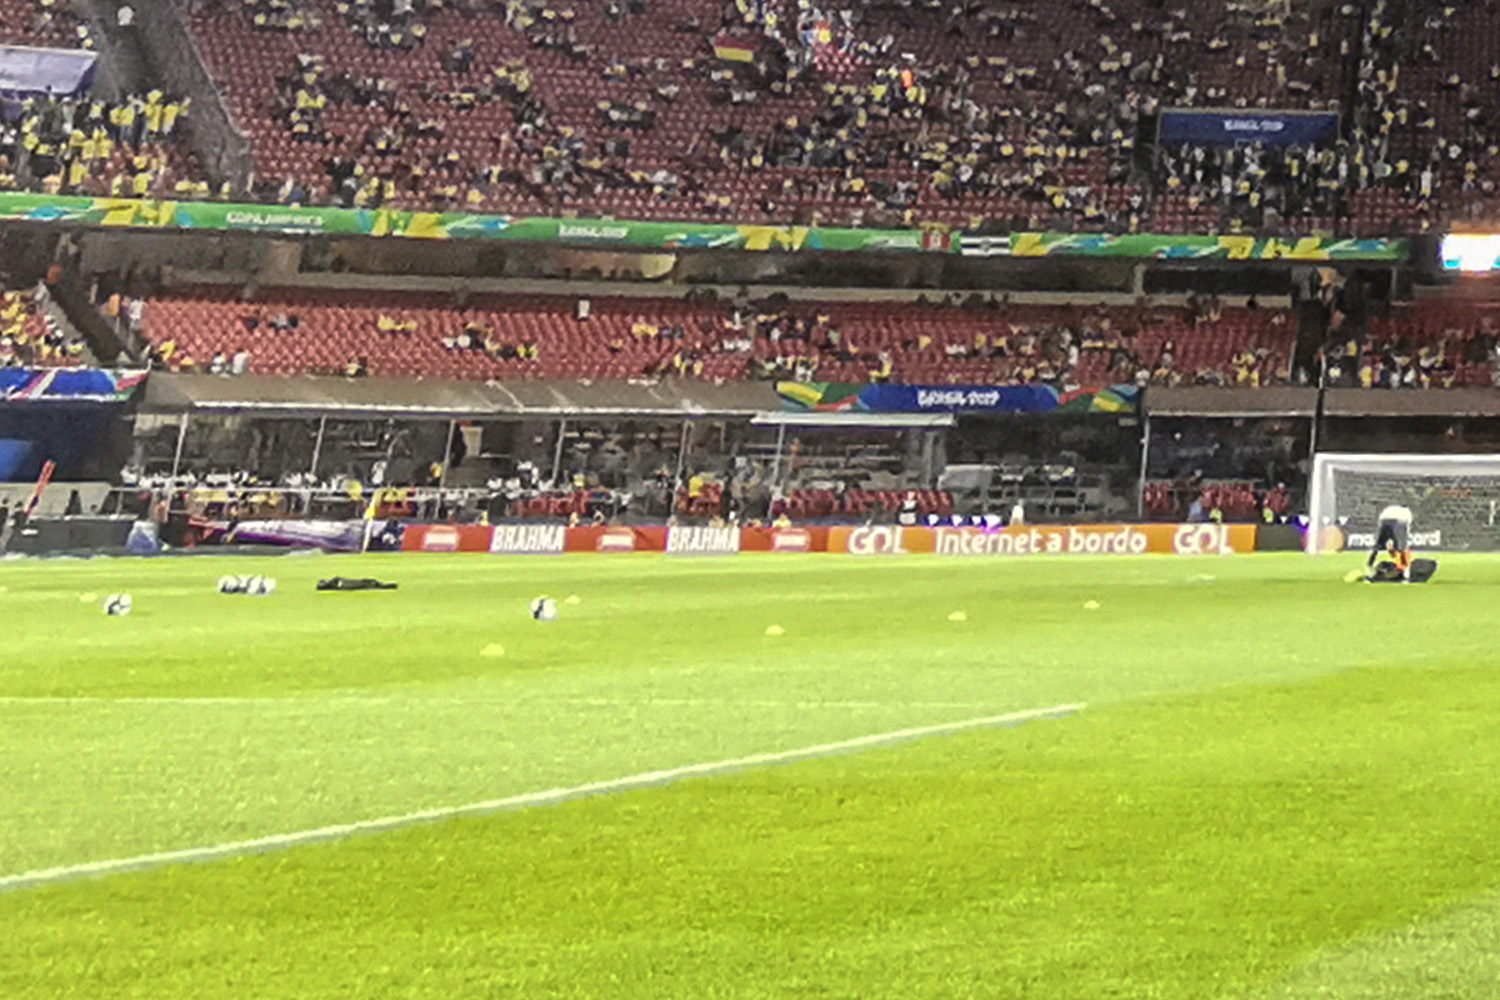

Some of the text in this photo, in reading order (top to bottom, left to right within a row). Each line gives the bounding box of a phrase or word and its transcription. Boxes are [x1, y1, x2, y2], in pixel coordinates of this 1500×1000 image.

[491, 525, 566, 551] BRAHMA
[668, 526, 739, 553] BRAHMA
[848, 525, 911, 554] GOL
[936, 529, 1147, 553] Internet a bordo
[1173, 524, 1236, 554] GOL
